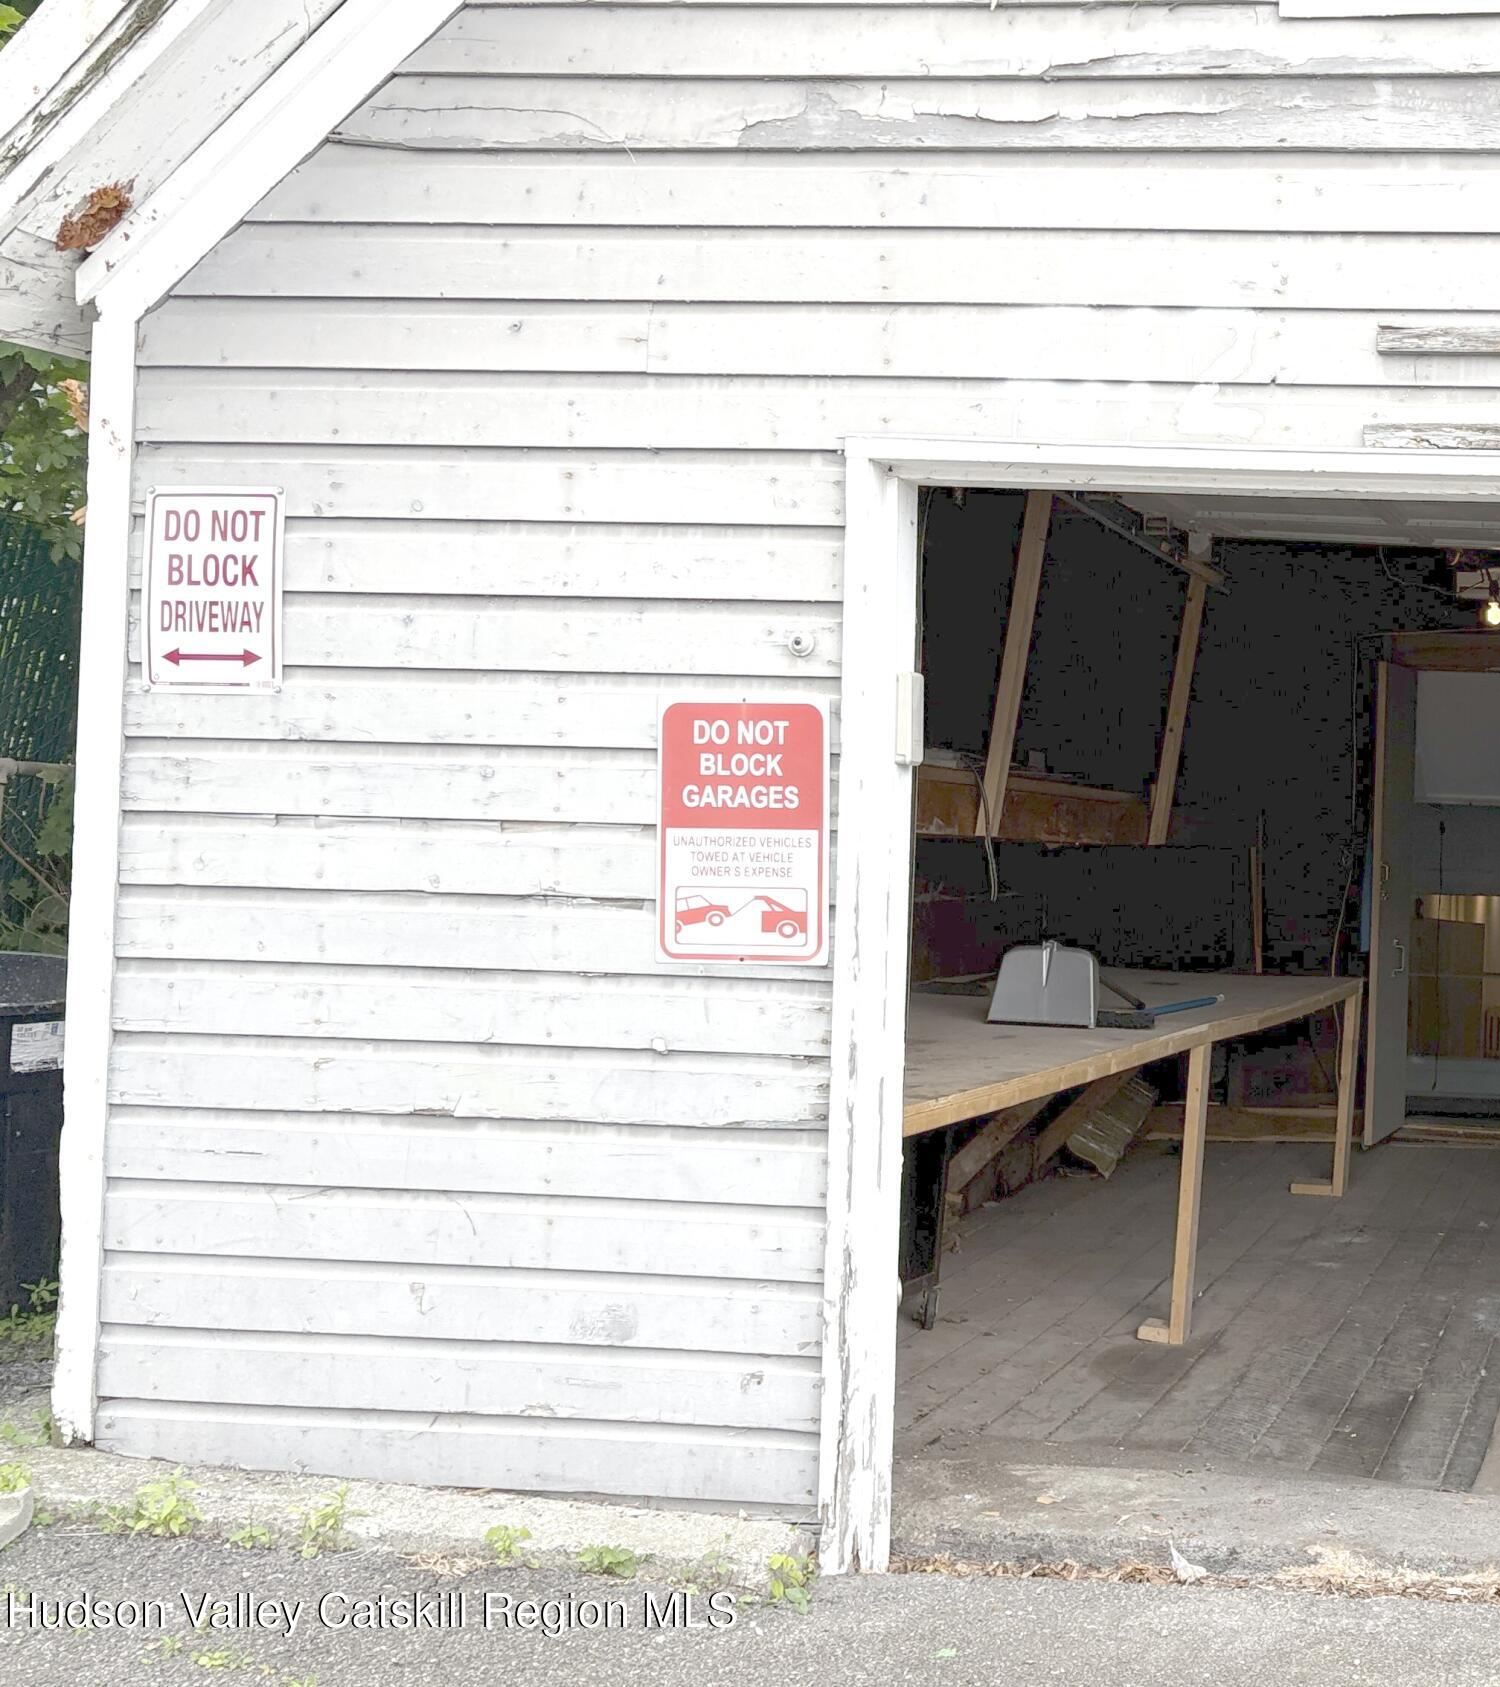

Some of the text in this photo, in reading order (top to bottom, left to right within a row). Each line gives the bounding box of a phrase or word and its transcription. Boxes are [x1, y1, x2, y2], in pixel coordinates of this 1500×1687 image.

[164, 509, 266, 542] DO NOT
[167, 553, 259, 587] BLOCK
[160, 600, 265, 633] DRIVEWAY
[693, 719, 789, 746] DO NOT
[699, 753, 783, 777] BLOCK
[682, 784, 800, 809] GARAGES
[673, 835, 812, 849] UNAUTHORIZED VEHICLES
[690, 851, 794, 864] TOWED AT VEHICLE
[691, 865, 793, 878] OWNERS EXPENSE
